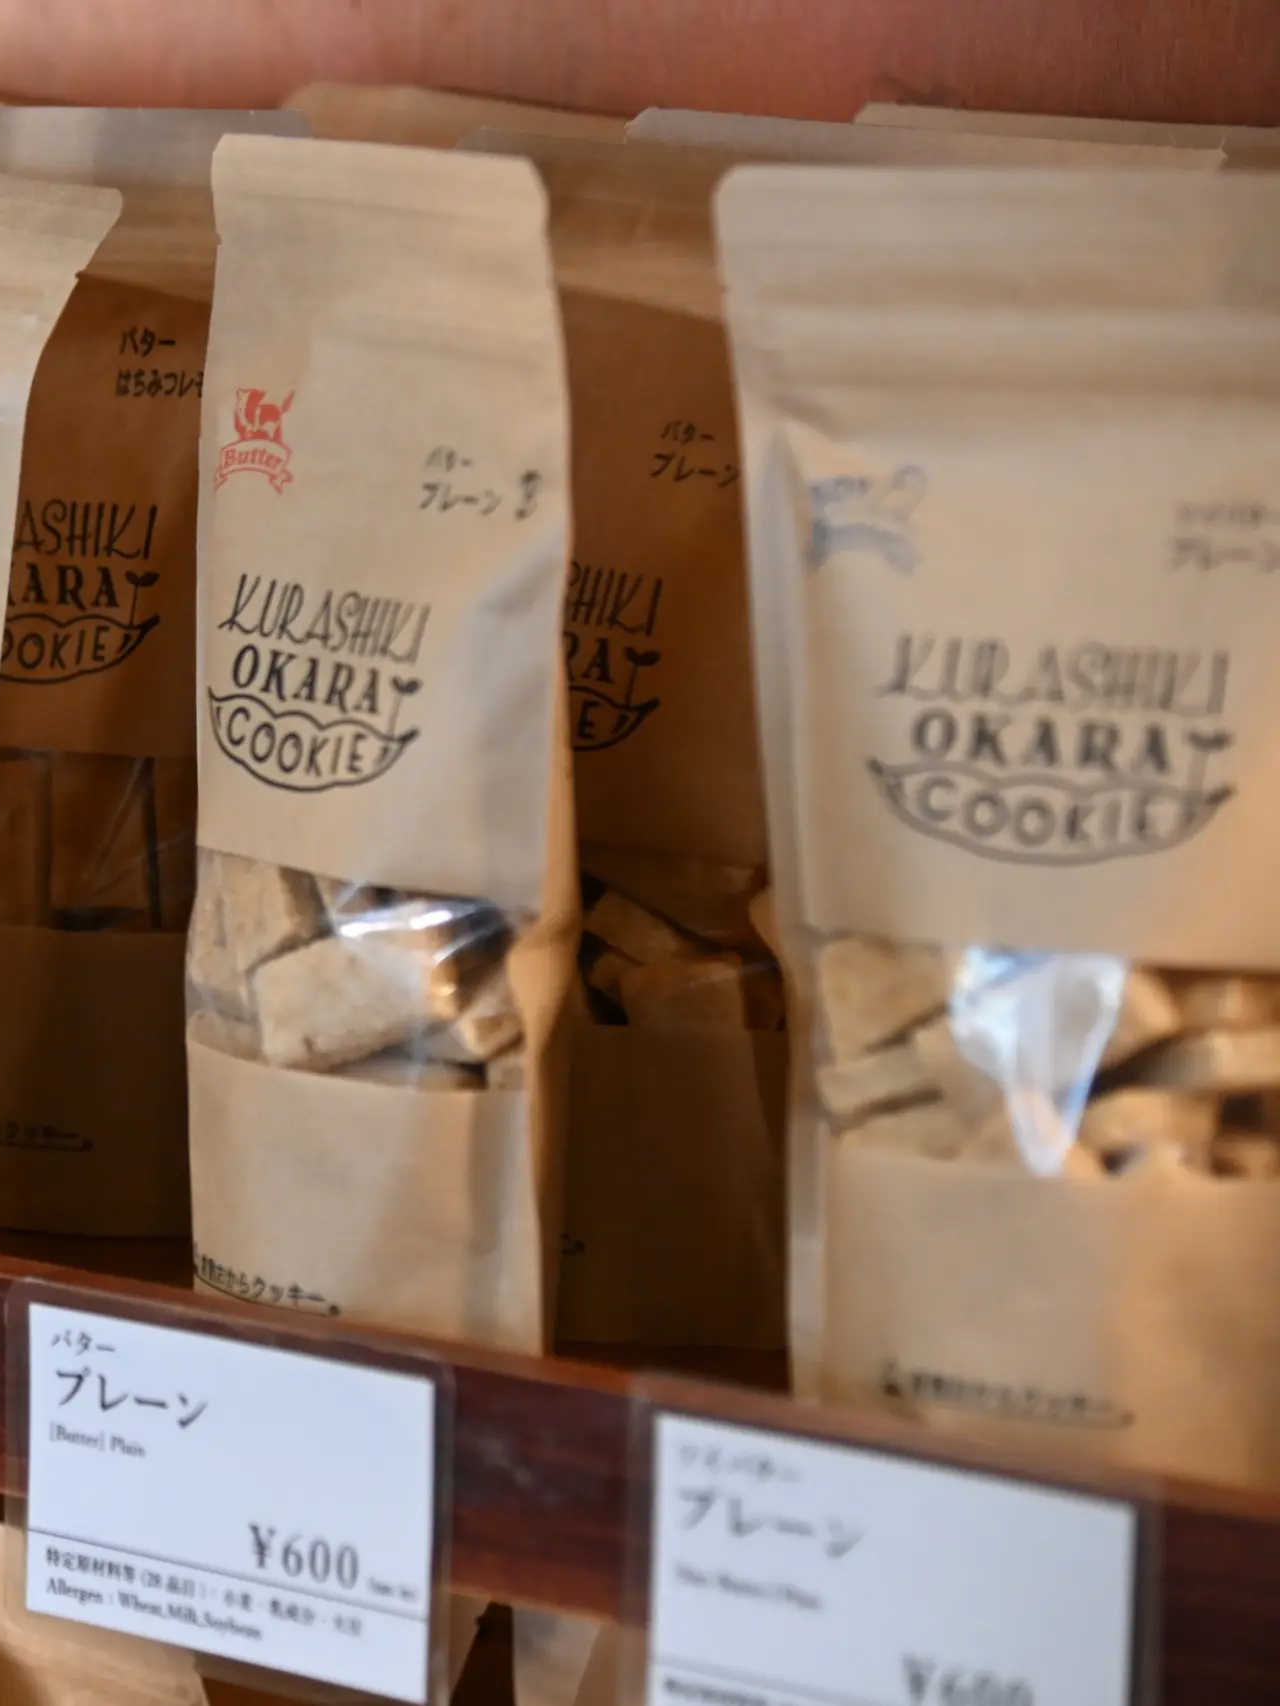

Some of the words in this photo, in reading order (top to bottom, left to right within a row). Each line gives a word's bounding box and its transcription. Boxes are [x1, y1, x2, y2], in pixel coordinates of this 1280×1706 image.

[120, 326, 175, 357] バター
[218, 573, 431, 665] KURASHIKI
[231, 643, 381, 715] OKARA
[227, 706, 366, 777] COOKIE
[910, 708, 1171, 776] OKARA
[51, 1330, 116, 1357] バター
[55, 1366, 209, 1430] プレーン
[248, 1521, 360, 1590] ¥600
